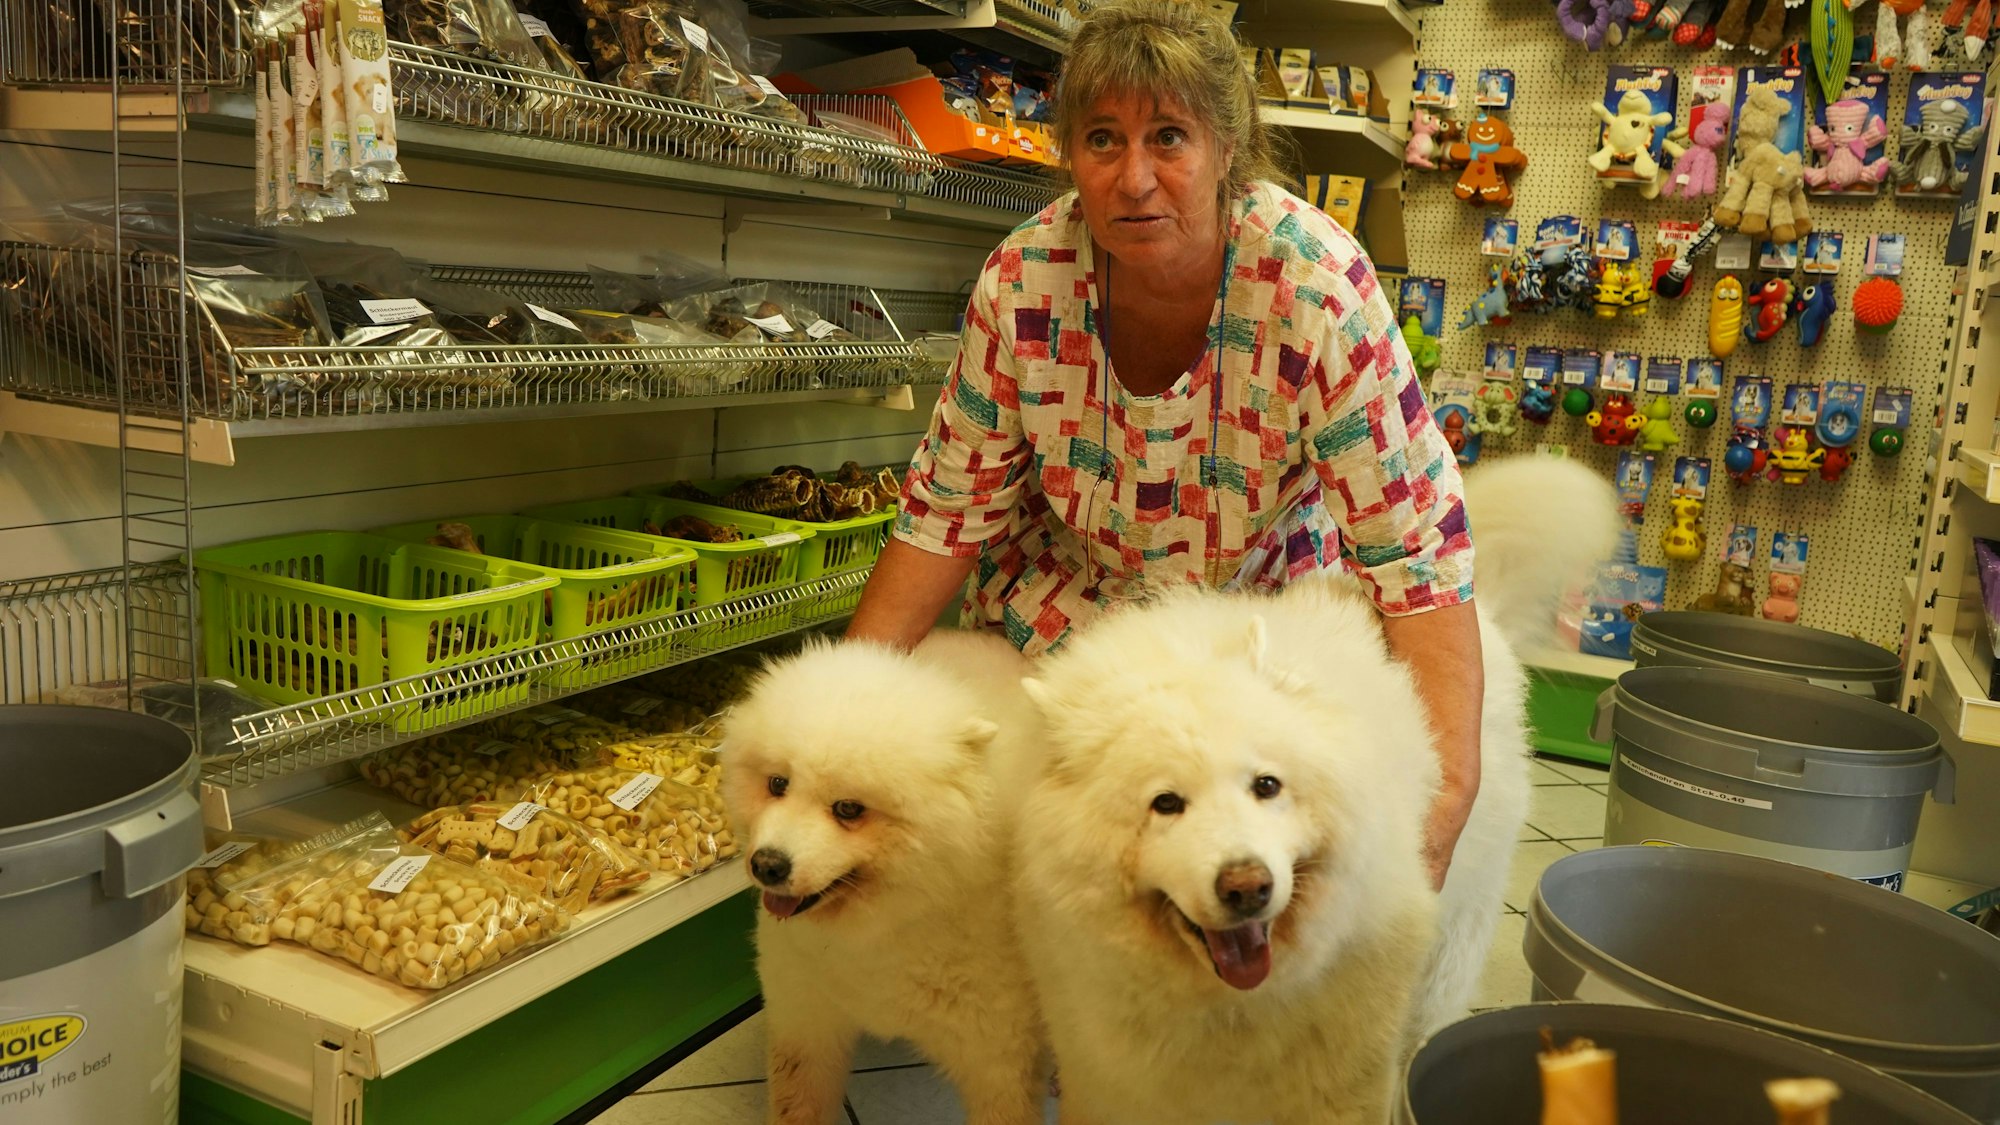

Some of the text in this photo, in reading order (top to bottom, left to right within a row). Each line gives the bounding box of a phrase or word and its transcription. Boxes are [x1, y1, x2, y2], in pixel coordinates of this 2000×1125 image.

[358, 14, 382, 23] SNACK
[1700, 77, 1720, 86] KONG
[1664, 231, 1684, 240] KONG
[369, 305, 418, 313] Schleckermaul
[52, 1071, 77, 1089] the
[83, 1052, 112, 1077] best
